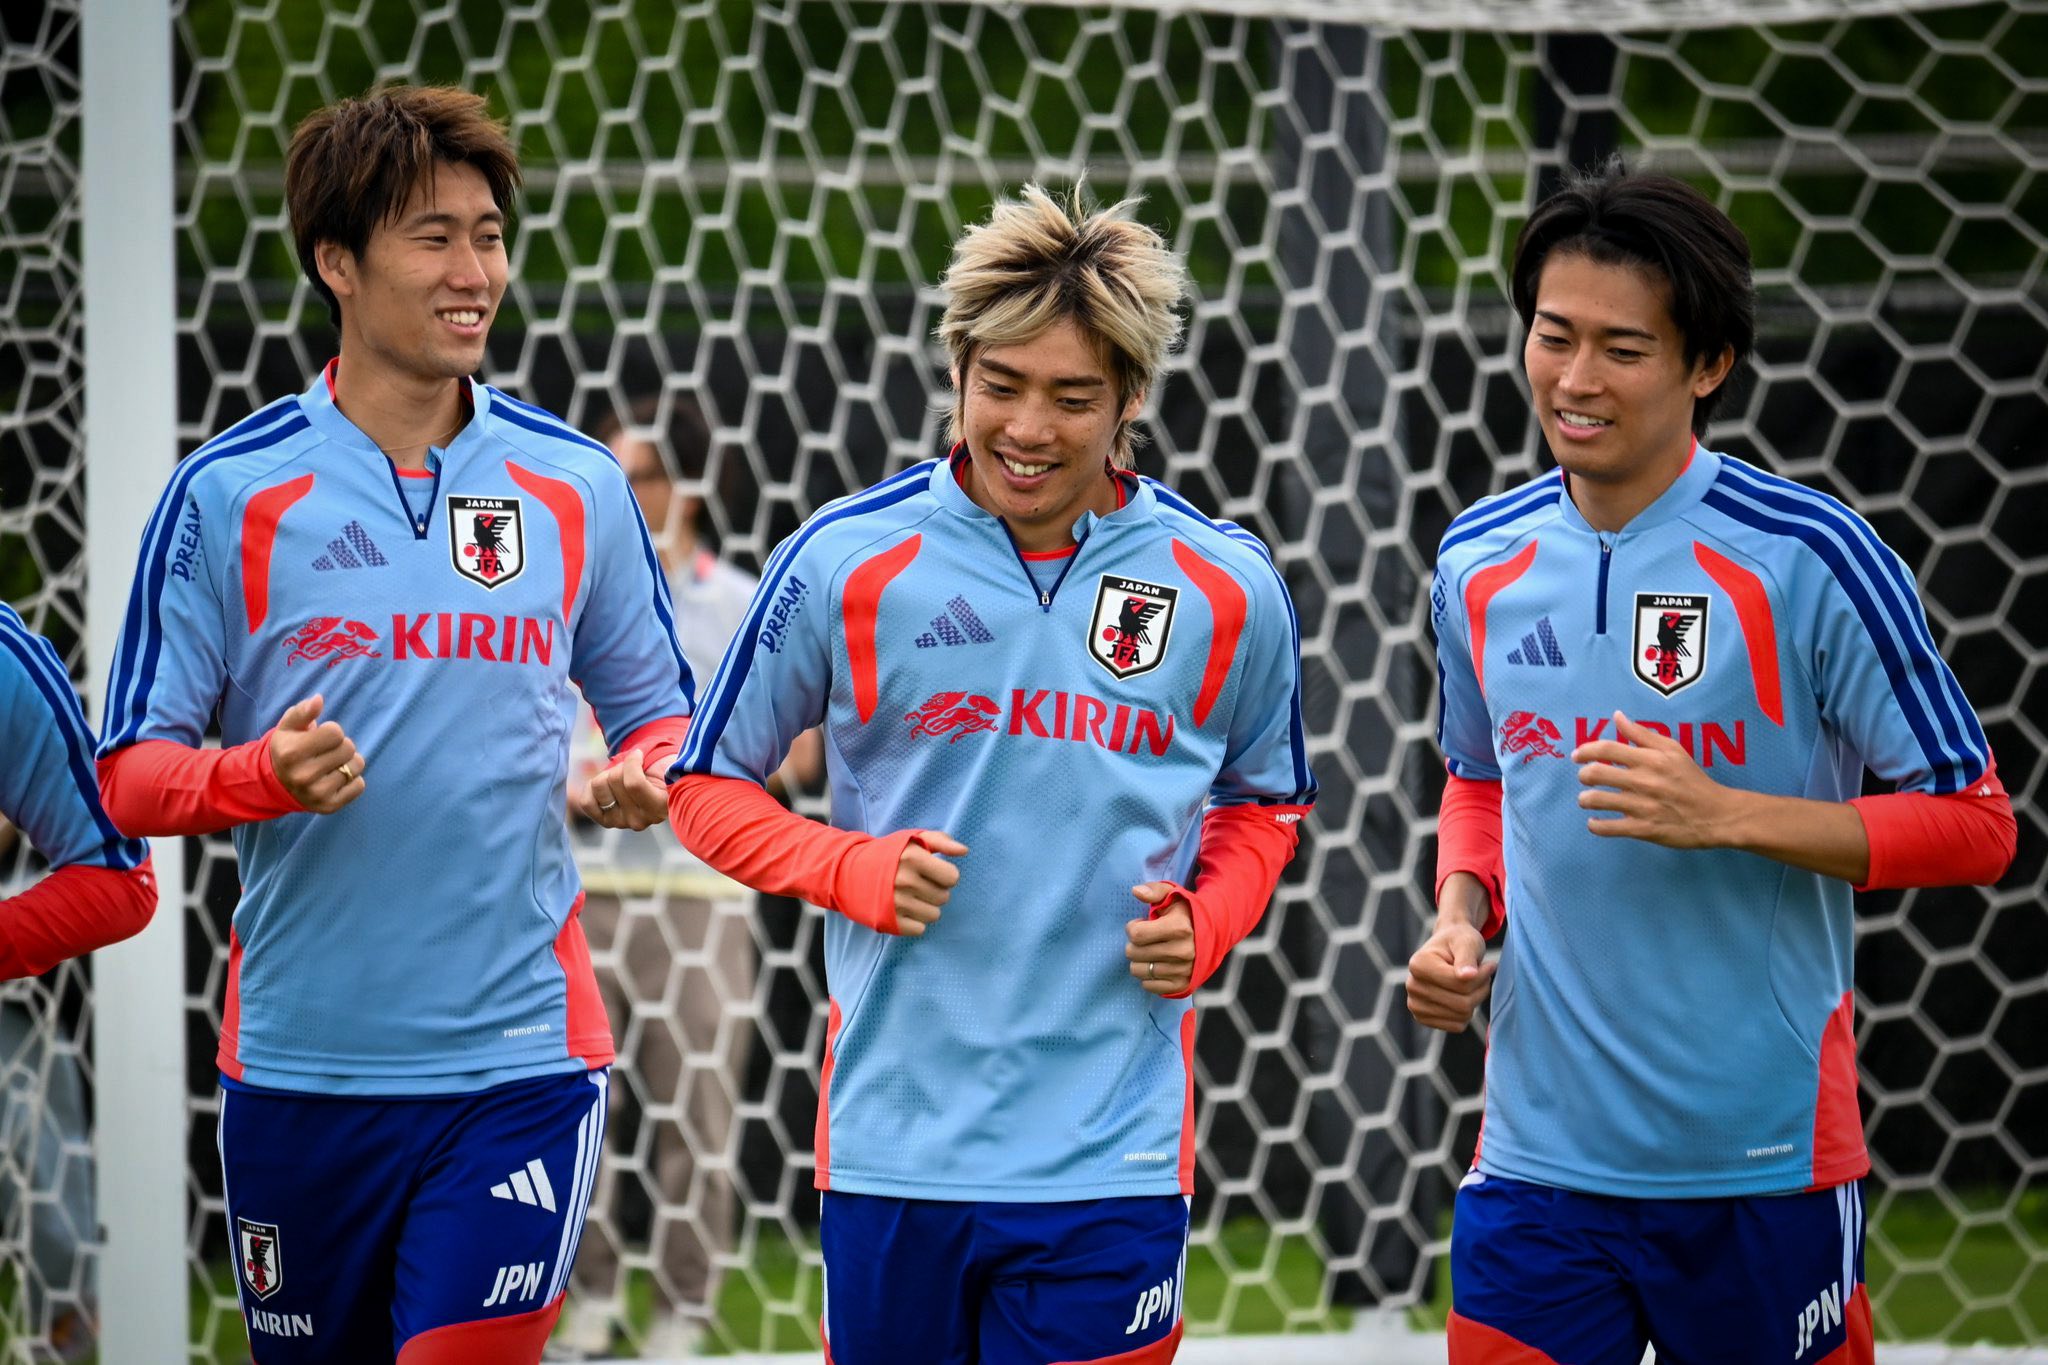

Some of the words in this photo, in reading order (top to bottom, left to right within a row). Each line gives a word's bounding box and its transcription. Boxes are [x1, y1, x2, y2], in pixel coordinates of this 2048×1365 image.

[465, 499, 503, 508] JAPAN
[472, 558, 505, 573] JFA
[1119, 581, 1160, 596] JAPAN
[1653, 596, 1692, 607] JAPAN
[758, 575, 807, 654] DREAM
[391, 612, 554, 666] KIRIN
[1106, 643, 1140, 665] JFA
[1651, 662, 1683, 678] JFA
[1008, 688, 1174, 757] KIRIN
[482, 1261, 545, 1307] JPN
[1125, 1276, 1173, 1335] JPN
[1795, 1281, 1842, 1360] JPN
[251, 1306, 314, 1338] KIRIN
